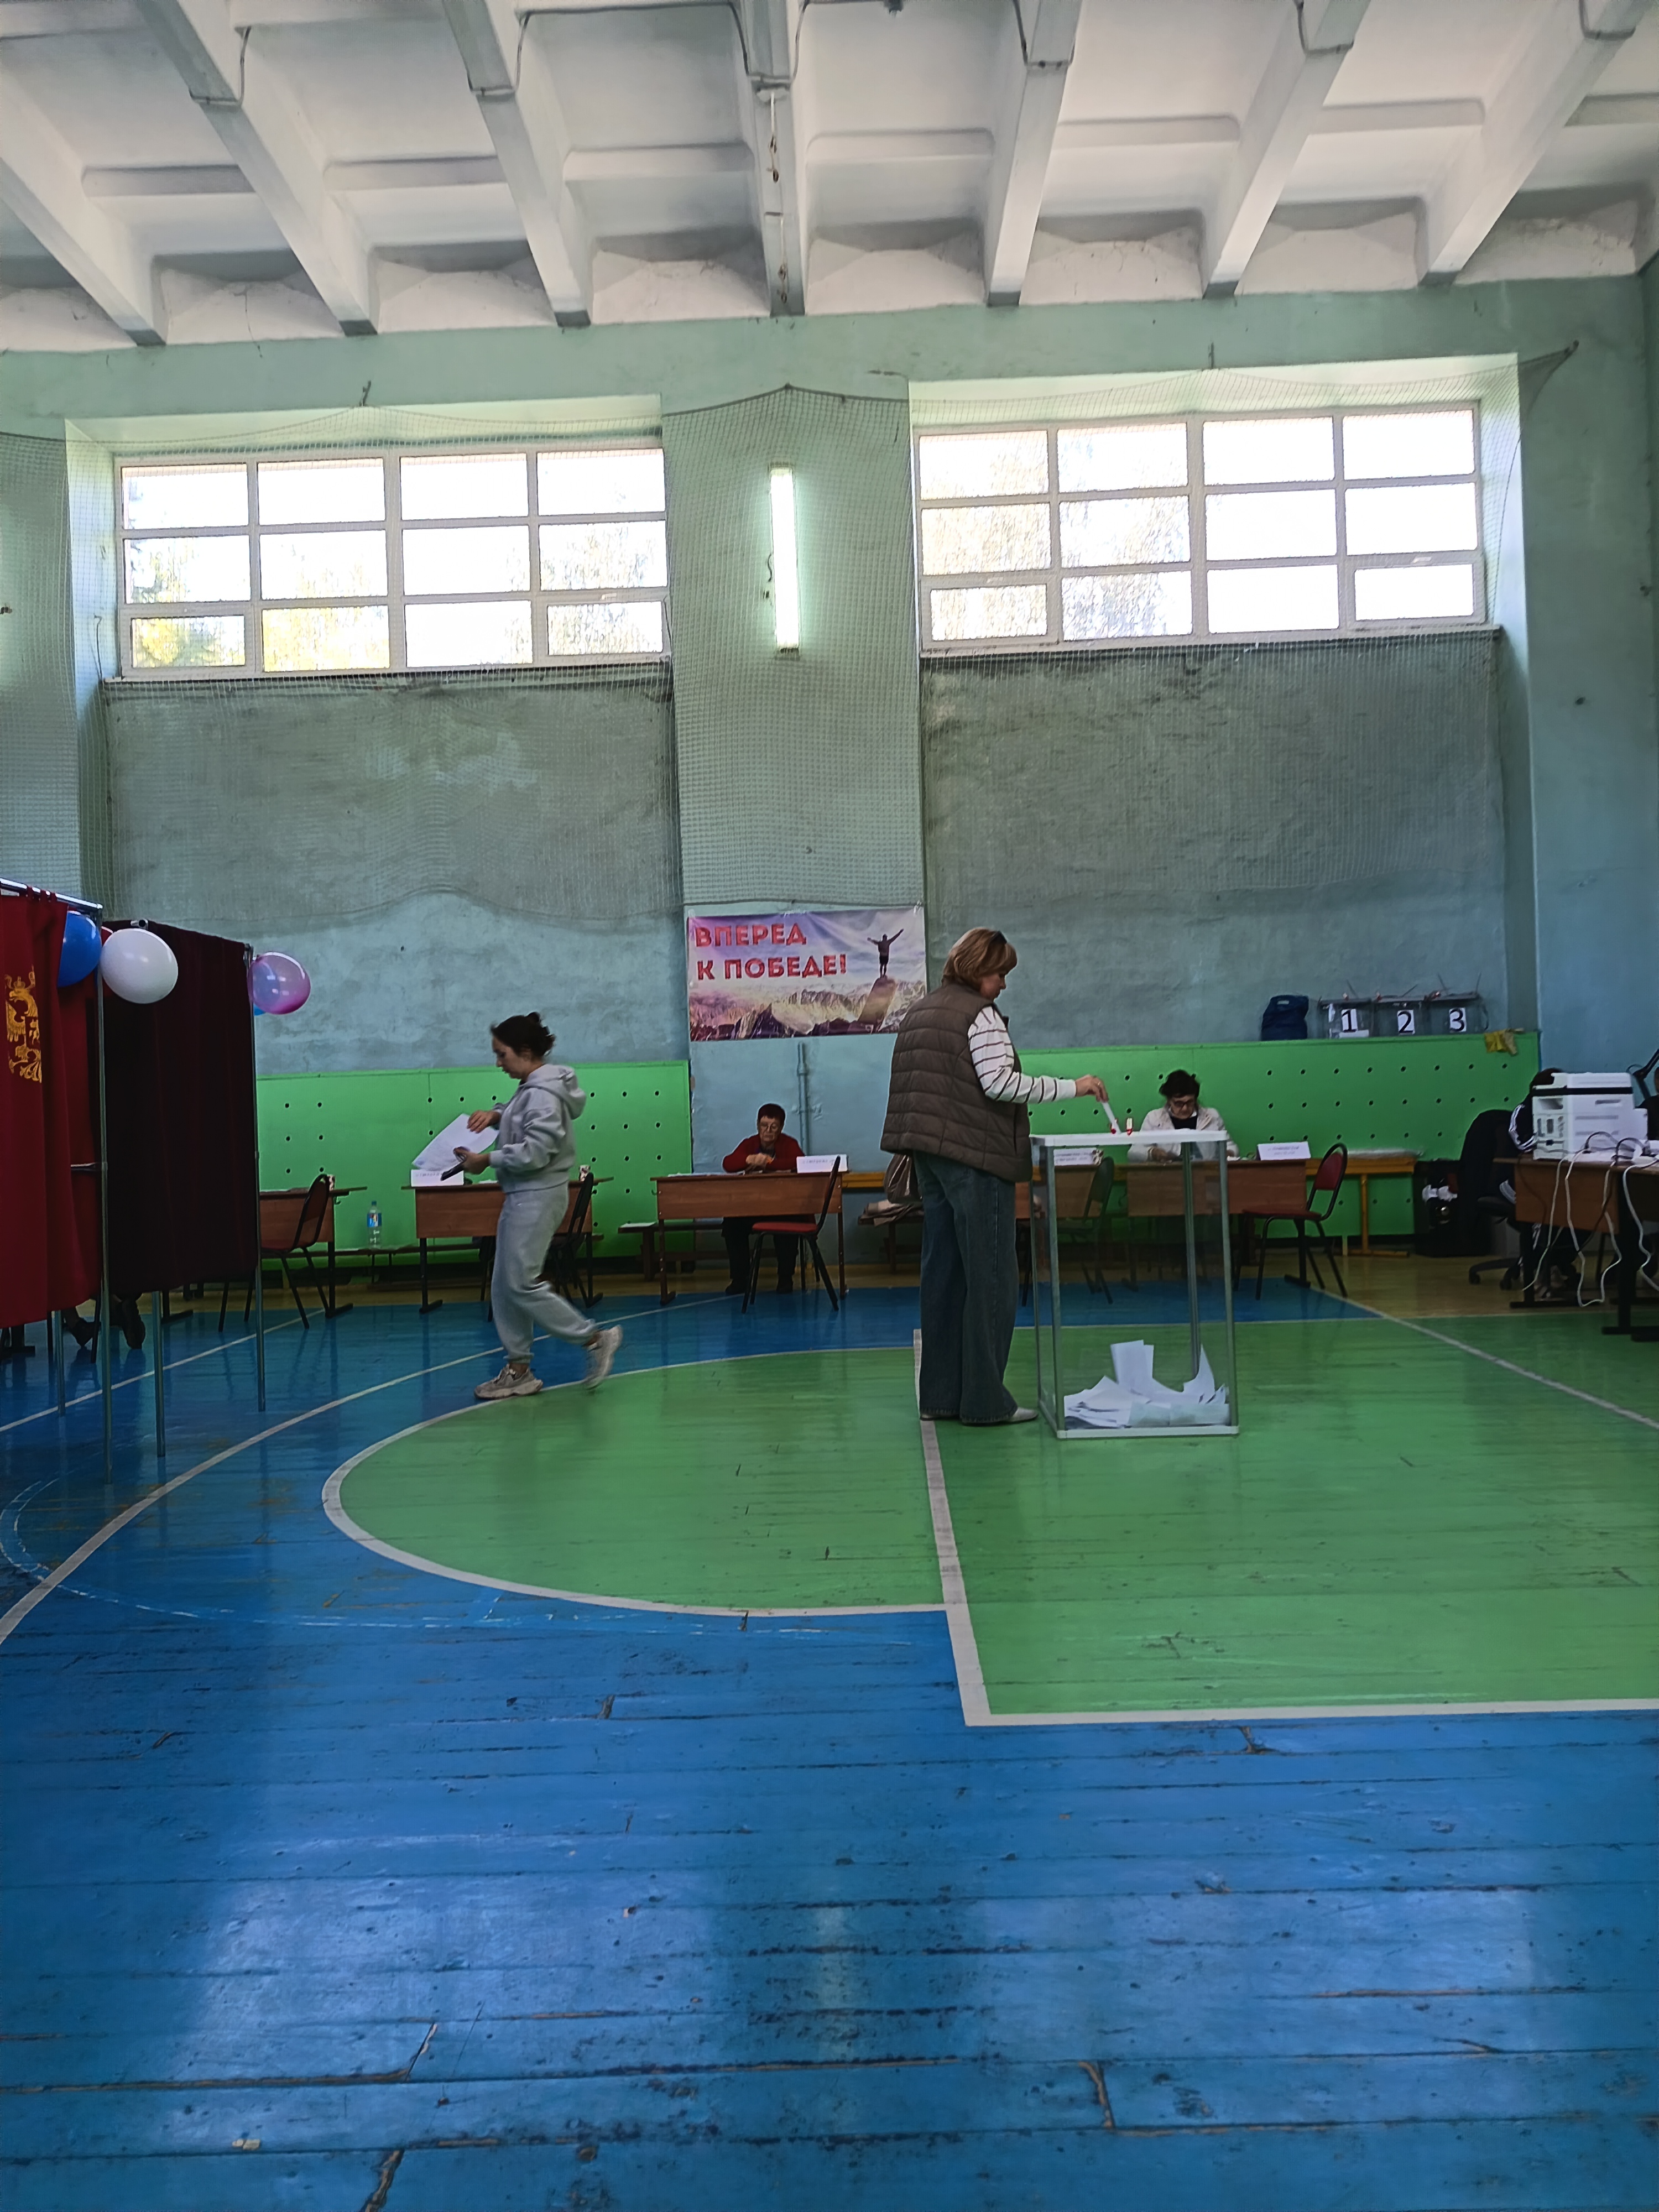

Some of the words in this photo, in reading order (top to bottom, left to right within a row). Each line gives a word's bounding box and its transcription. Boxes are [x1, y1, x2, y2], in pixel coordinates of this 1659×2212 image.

[696, 923, 806, 947] ВПЕРЕД
[697, 959, 715, 980] К
[724, 954, 847, 979] ПОБЕДЕ!
[1342, 1010, 1357, 1032] 1
[1397, 1011, 1413, 1033] 2
[1450, 1009, 1465, 1031] 3
